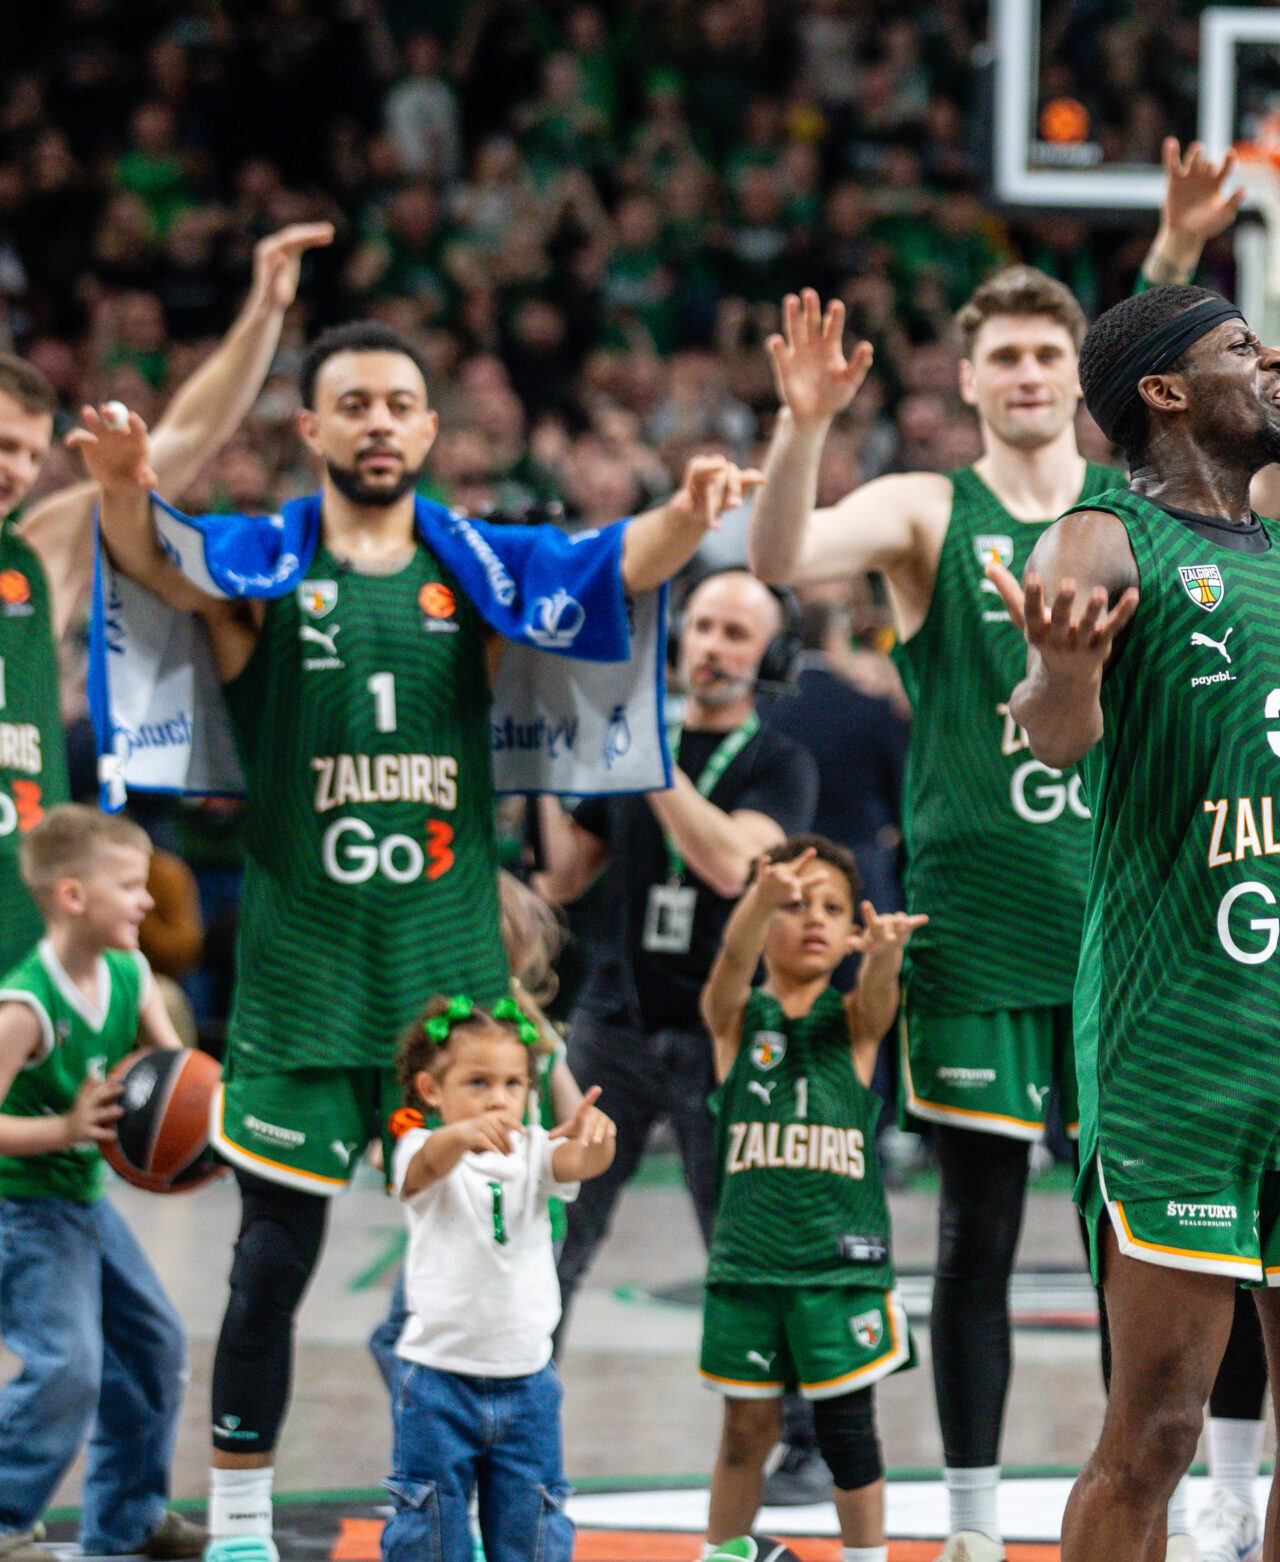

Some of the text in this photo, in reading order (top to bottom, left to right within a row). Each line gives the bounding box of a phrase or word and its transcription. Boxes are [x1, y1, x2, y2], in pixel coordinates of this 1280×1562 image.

[367, 671, 397, 733] 1
[322, 816, 455, 885] Go3
[795, 1077, 808, 1119] 1
[486, 1181, 508, 1246] 1
[1167, 1201, 1237, 1219] ŠVYTURYS
